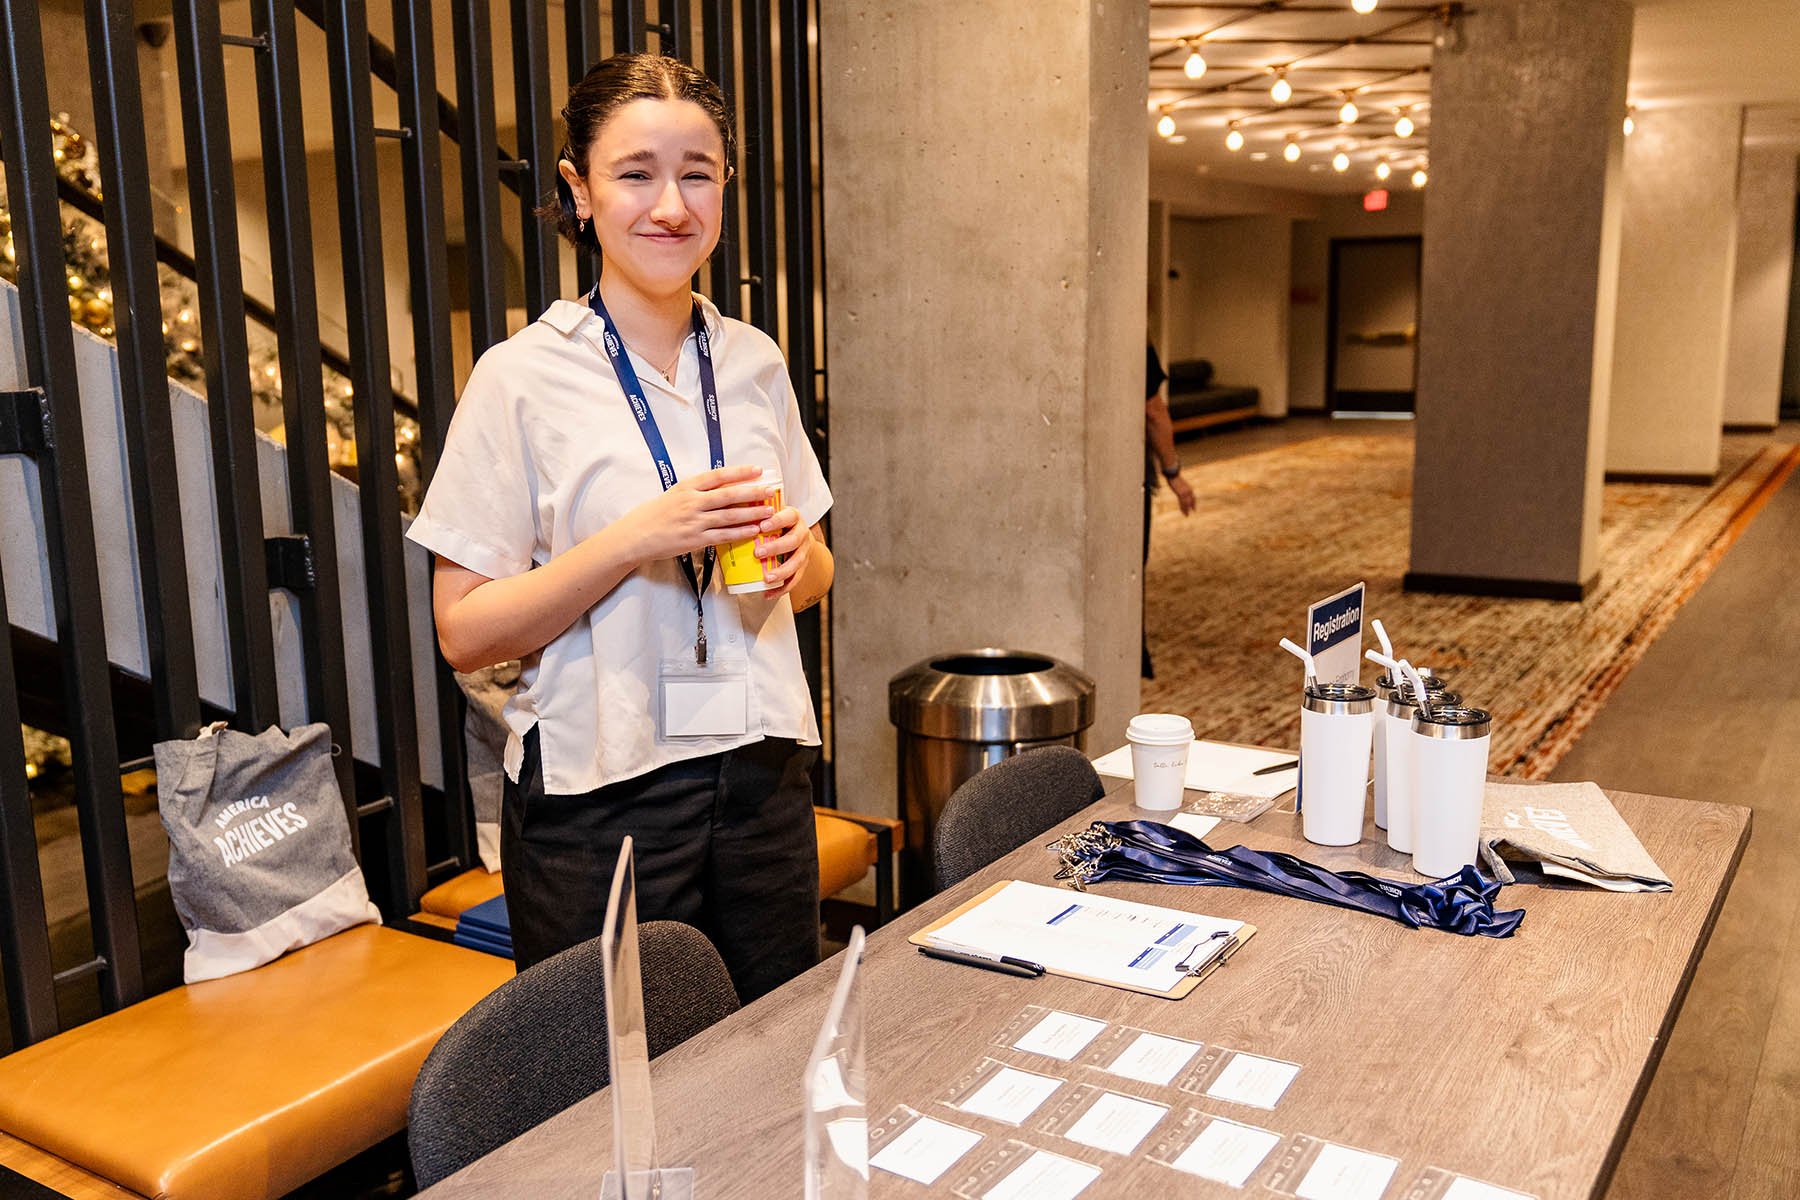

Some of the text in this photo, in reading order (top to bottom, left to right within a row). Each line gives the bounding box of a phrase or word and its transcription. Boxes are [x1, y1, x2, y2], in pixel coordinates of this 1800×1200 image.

[603, 331, 619, 357] ACHIEVES
[700, 331, 709, 357] ACHIEVES
[629, 394, 646, 421] ACHIEVES
[708, 394, 718, 421] ACHIEVES
[657, 460, 672, 489] ACHIEVES
[1313, 606, 1360, 642] Registration
[215, 795, 270, 829] AMERICA
[213, 802, 308, 868] ACHIEVES
